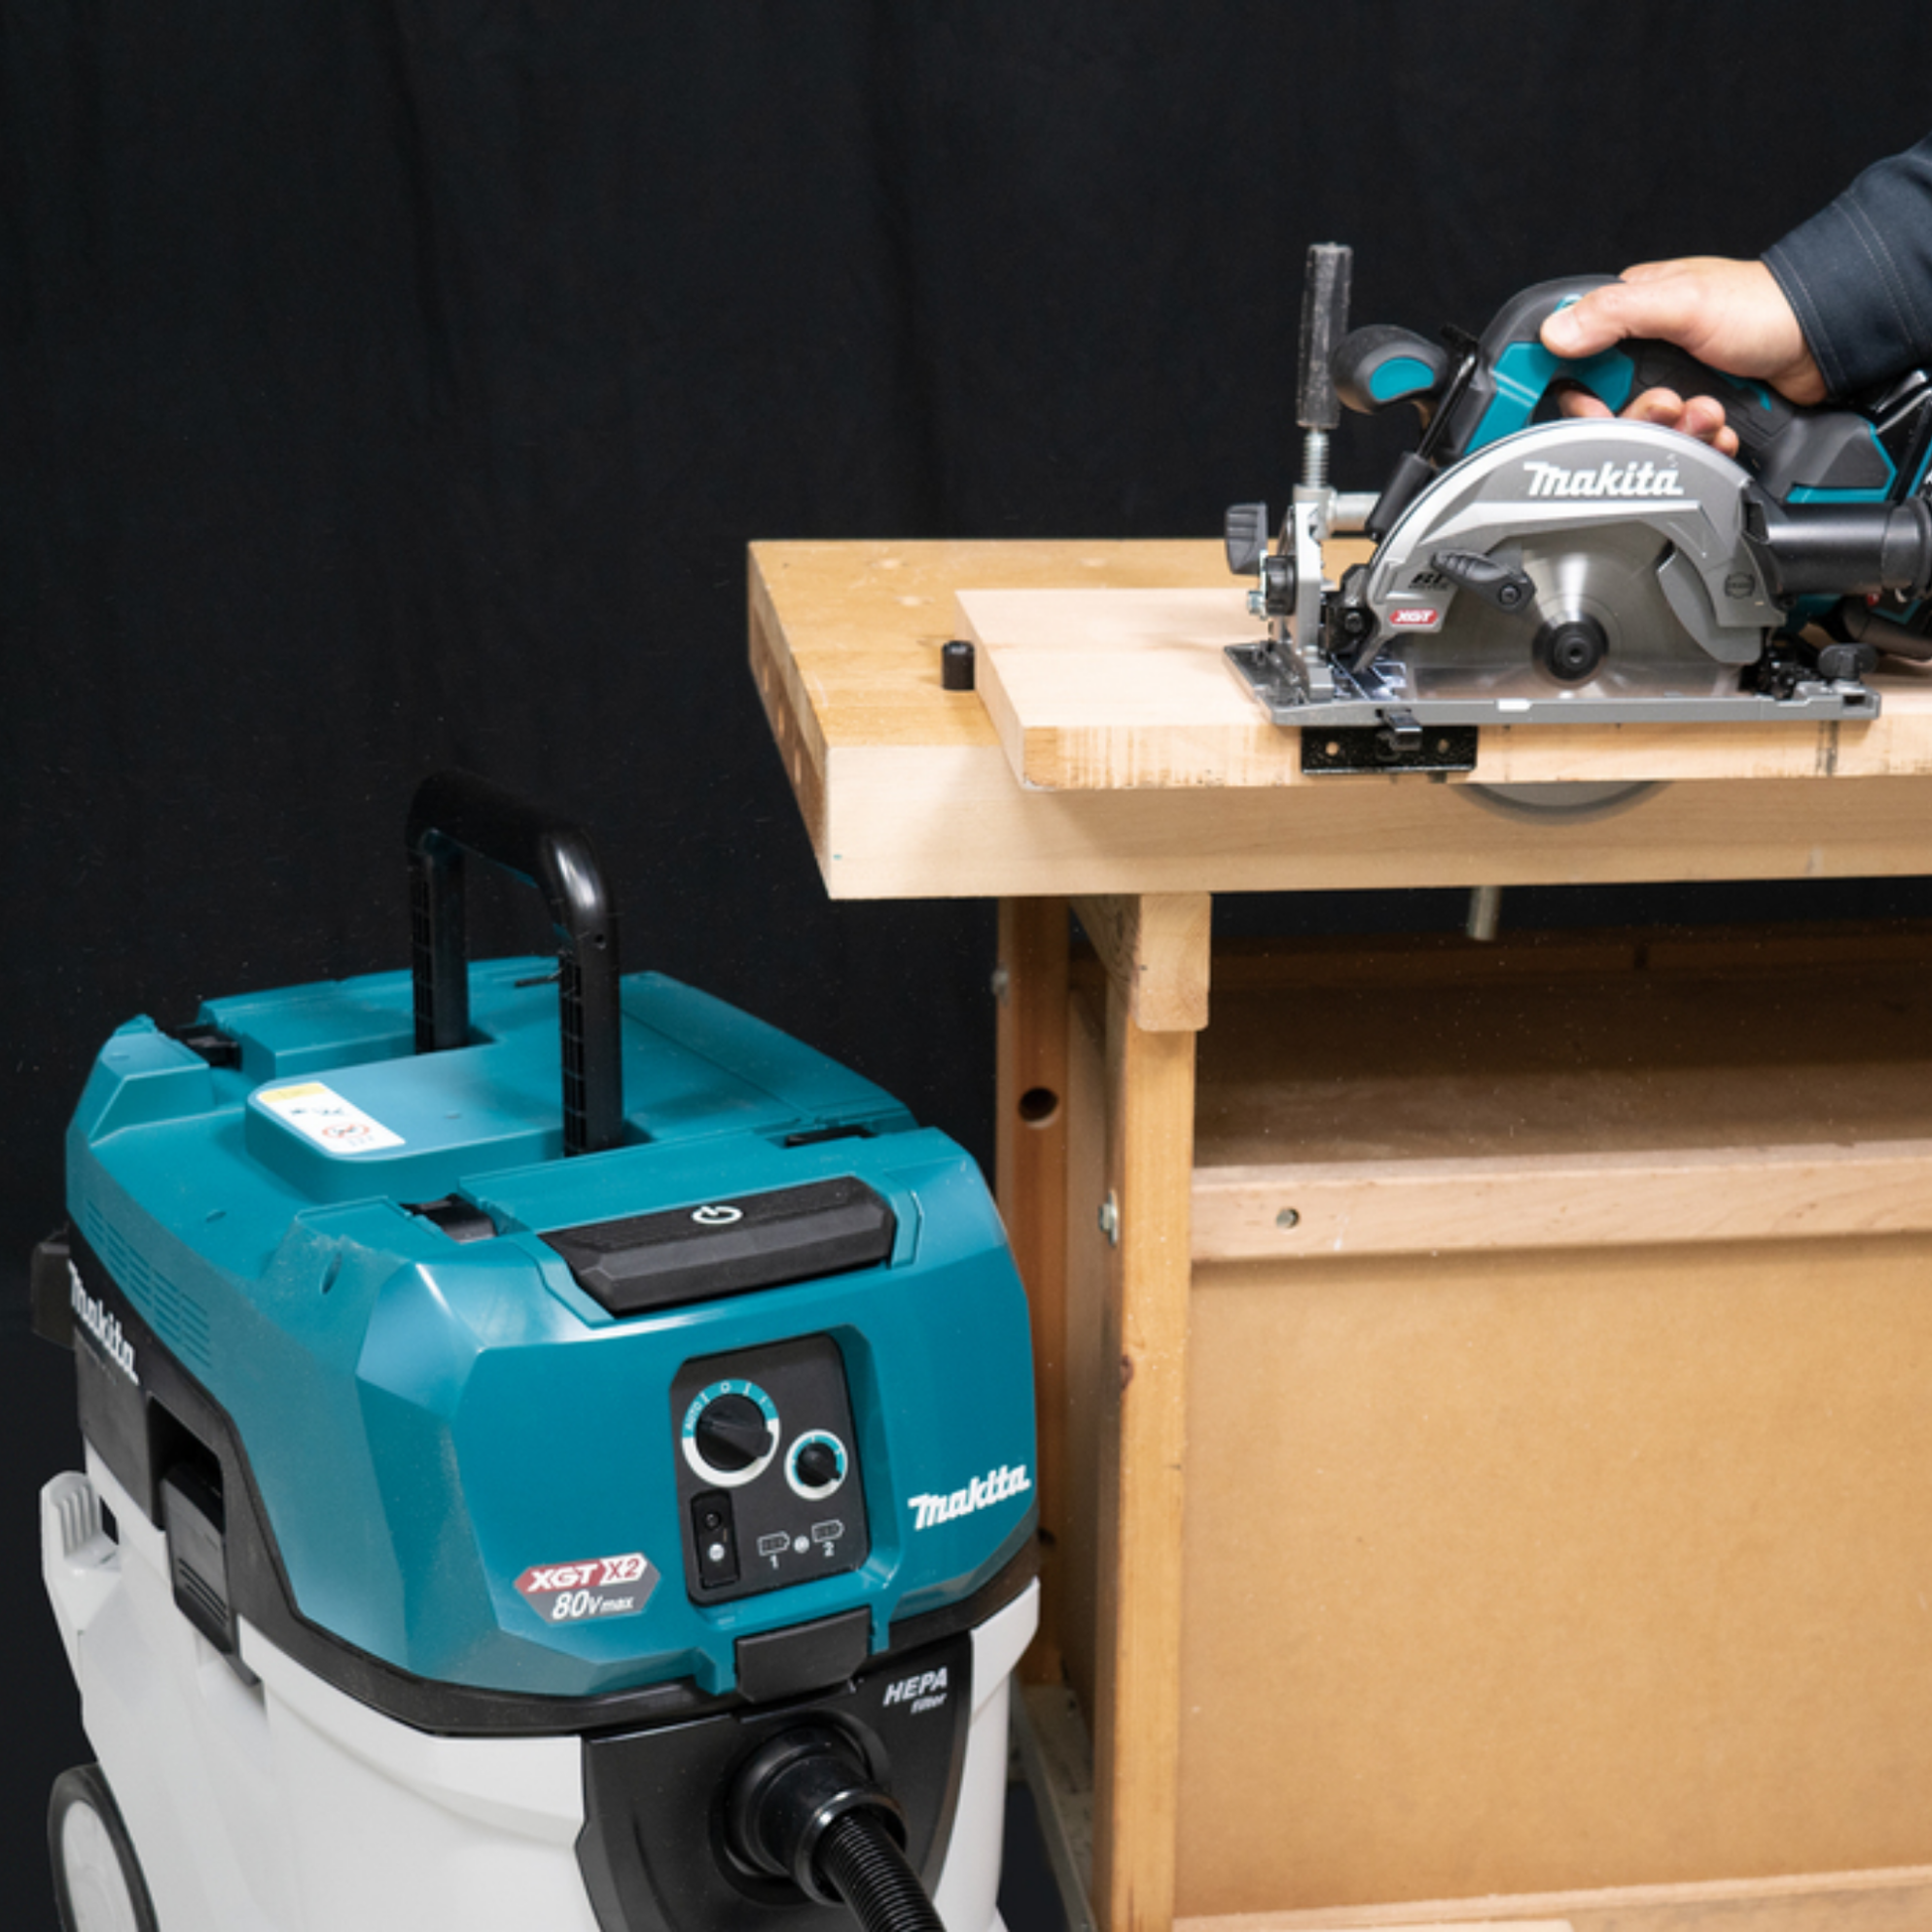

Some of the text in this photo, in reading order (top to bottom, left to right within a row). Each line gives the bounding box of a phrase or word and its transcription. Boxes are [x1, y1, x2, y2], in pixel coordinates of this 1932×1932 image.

[1523, 461, 1685, 496] Makita
[67, 1258, 140, 1386] Makita
[907, 1463, 1033, 1531] Makita
[525, 1557, 640, 1592] XGT X2
[769, 1540, 835, 1571] 1 2
[883, 1667, 948, 1708] HEPA
